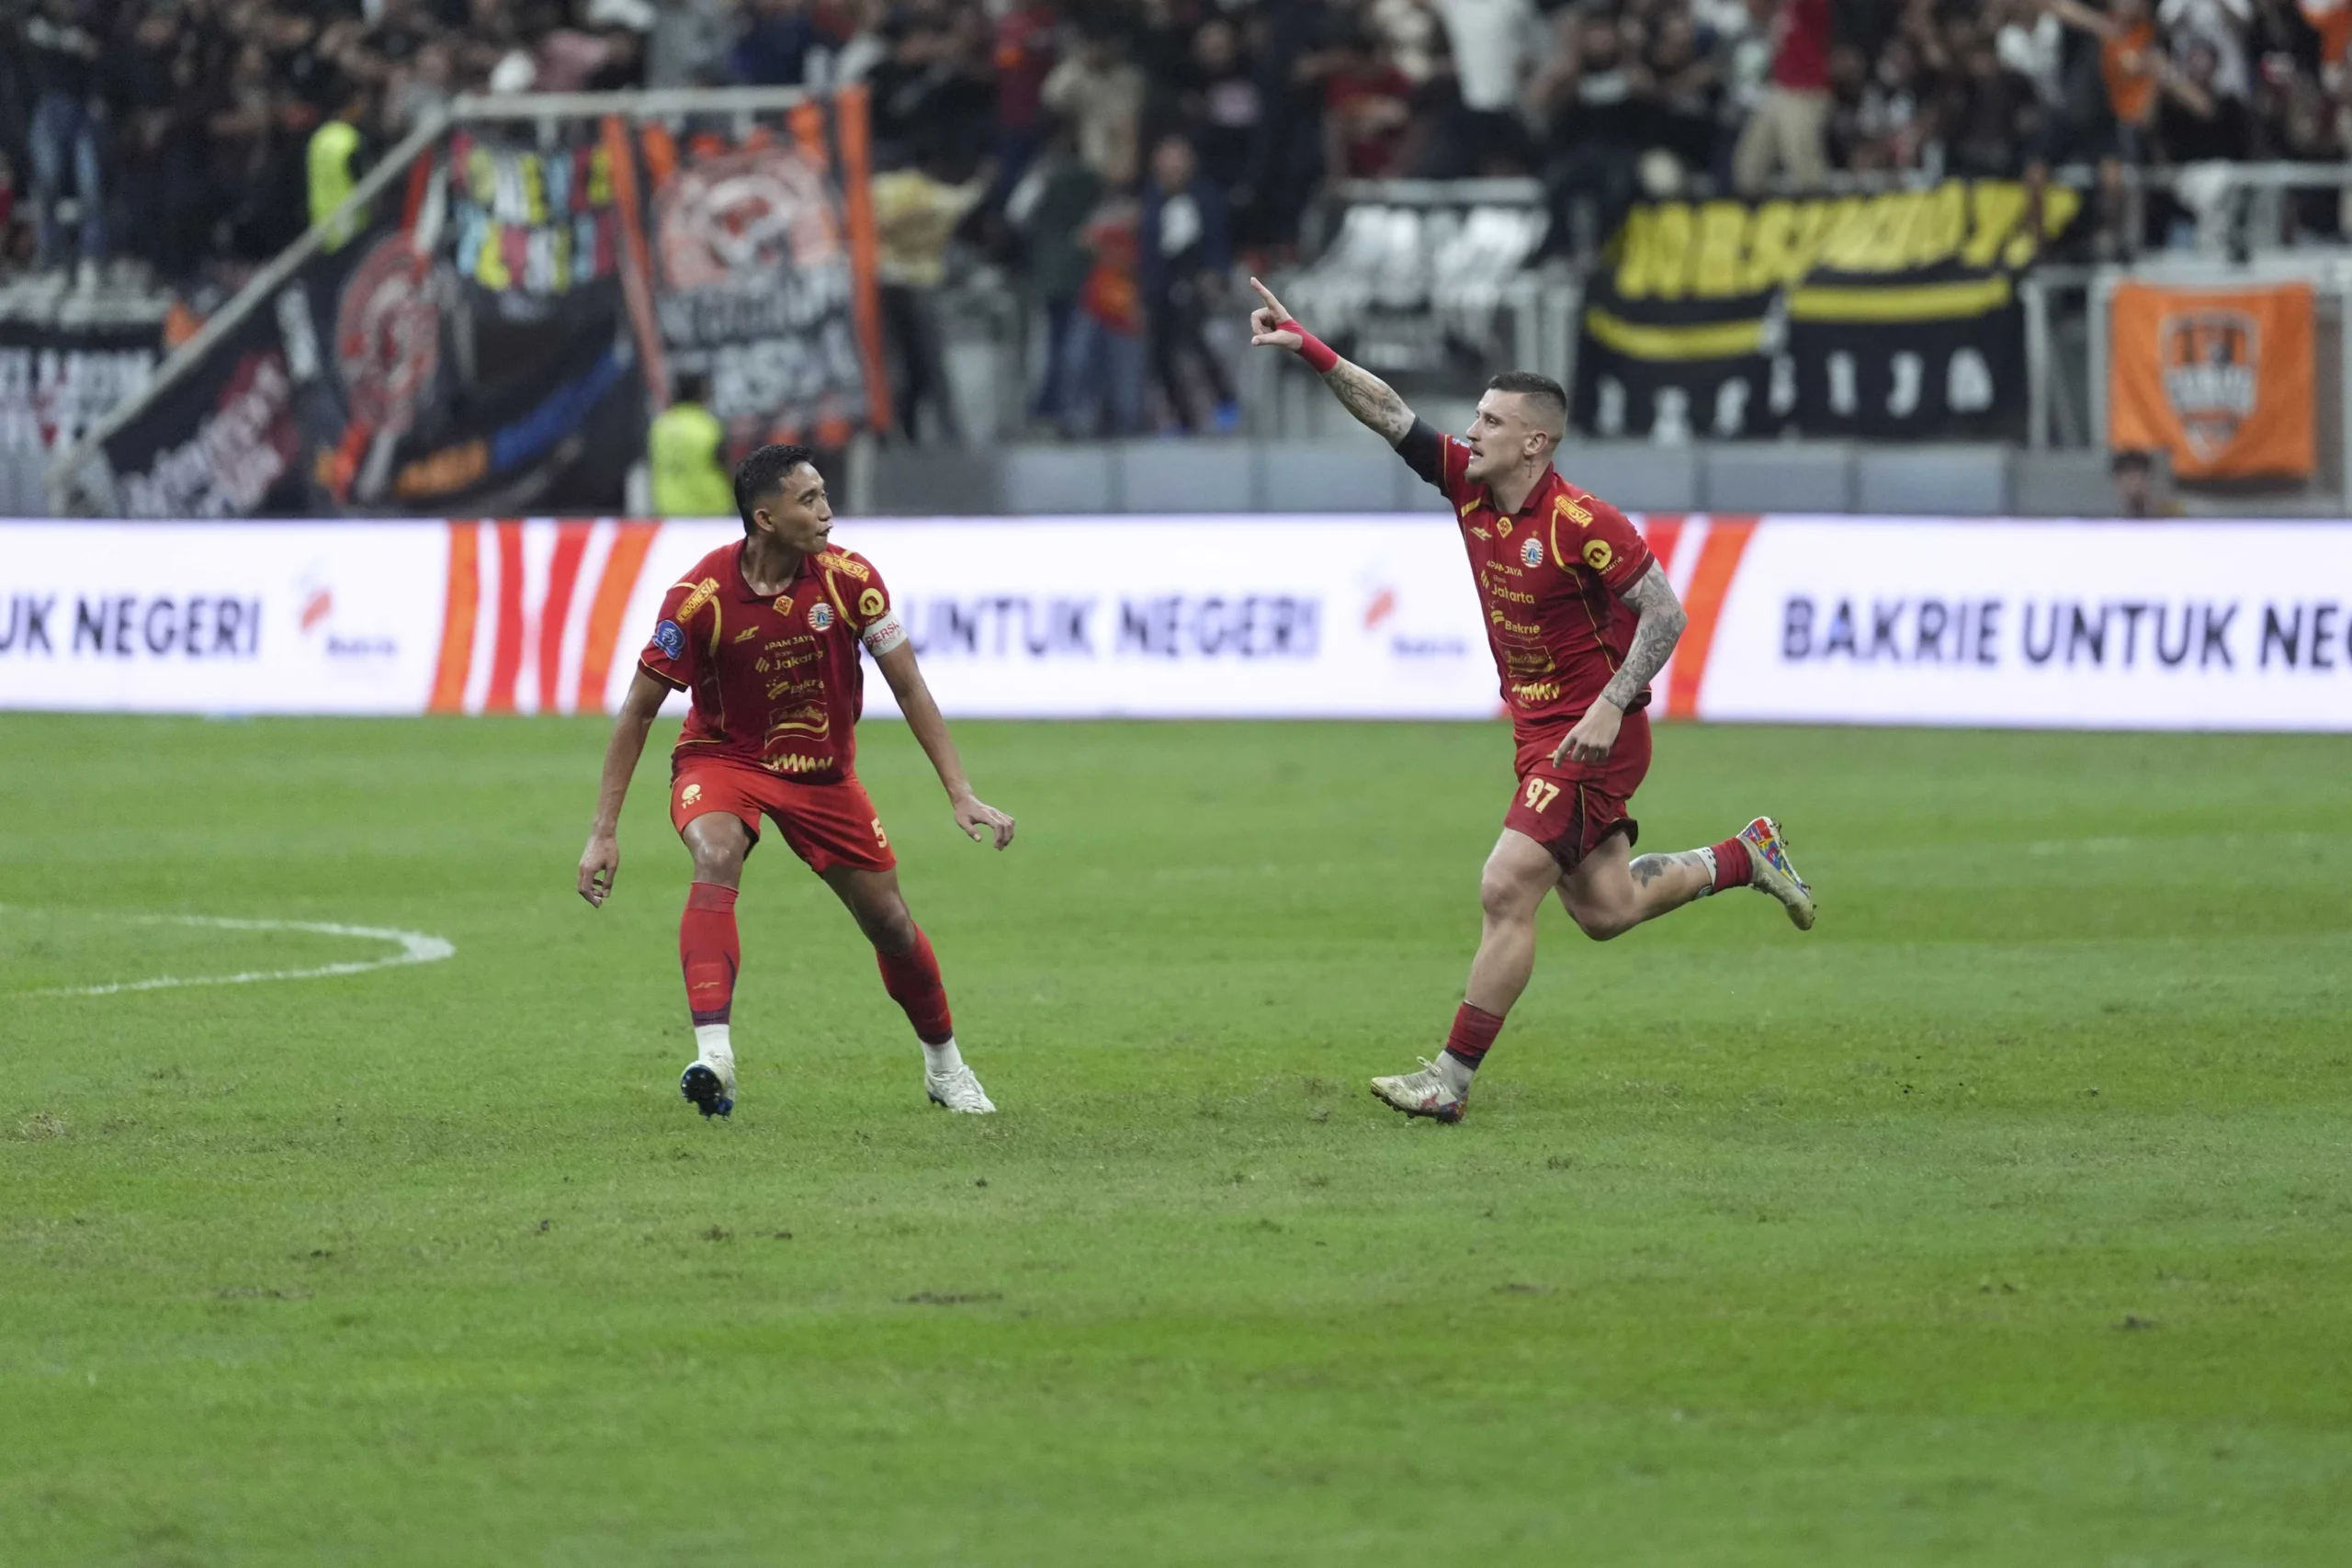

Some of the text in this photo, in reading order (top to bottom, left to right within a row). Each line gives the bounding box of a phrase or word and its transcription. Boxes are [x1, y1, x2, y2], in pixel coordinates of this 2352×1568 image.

[1504, 566, 1522, 577] JAYA
[1491, 584, 1535, 604] Jakarta
[74, 595, 260, 656] NEGERI
[904, 595, 1320, 658] UNTUK NEGERI
[1505, 619, 1541, 634] Bakrie
[1783, 597, 2352, 671] BAKRIE UNTUK NE
[769, 635, 815, 649] PAM JAYA
[774, 650, 823, 671] Jakara
[1524, 778, 1560, 814] 97
[871, 818, 888, 848] 5
